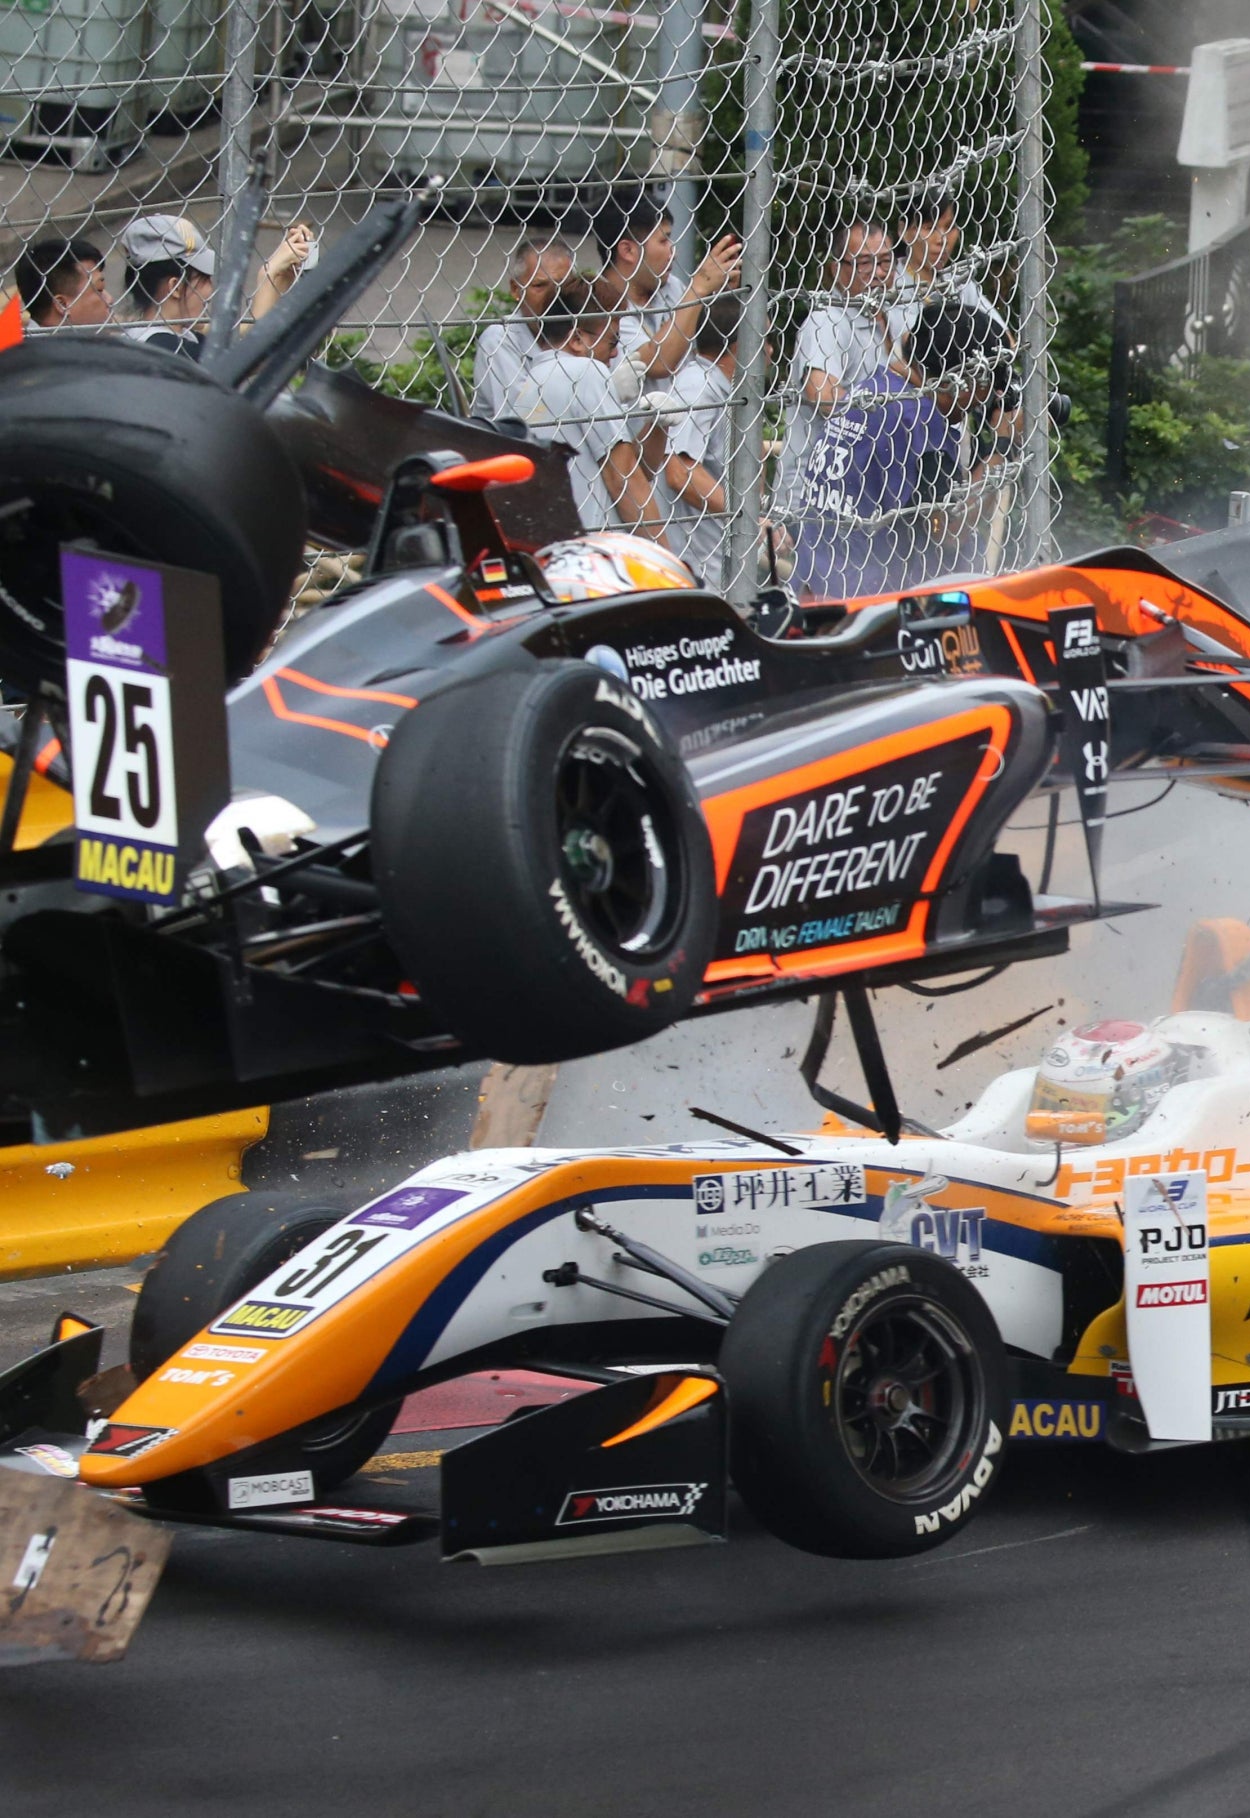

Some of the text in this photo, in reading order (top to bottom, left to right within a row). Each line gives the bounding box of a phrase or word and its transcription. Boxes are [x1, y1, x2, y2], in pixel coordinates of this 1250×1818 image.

[625, 644, 680, 670] Hüsges
[631, 657, 761, 699] Die Gutachter
[85, 674, 161, 829] 25
[762, 771, 943, 859] DARE TO BE
[78, 838, 175, 896] MACAU
[744, 831, 927, 914] DIFFERENT
[549, 878, 628, 998] YOKOHAMA
[798, 911, 856, 944] FEMALE
[854, 903, 900, 933] TALENT
[732, 1164, 864, 1210] 坪井工業
[910, 1207, 987, 1263] CVT
[274, 1229, 390, 1299] 31
[828, 1265, 910, 1340] YOKOHAMA
[1140, 1282, 1205, 1306] MOTUL
[222, 1304, 310, 1330] MACAU
[209, 1347, 259, 1360] TOYOTA
[158, 1368, 235, 1387] TOM'S
[1009, 1403, 1100, 1438] ACAU
[251, 1477, 309, 1494] MOBCAST
[914, 1419, 1003, 1535] ADVAN
[596, 1492, 681, 1513] YOKOHAMA
